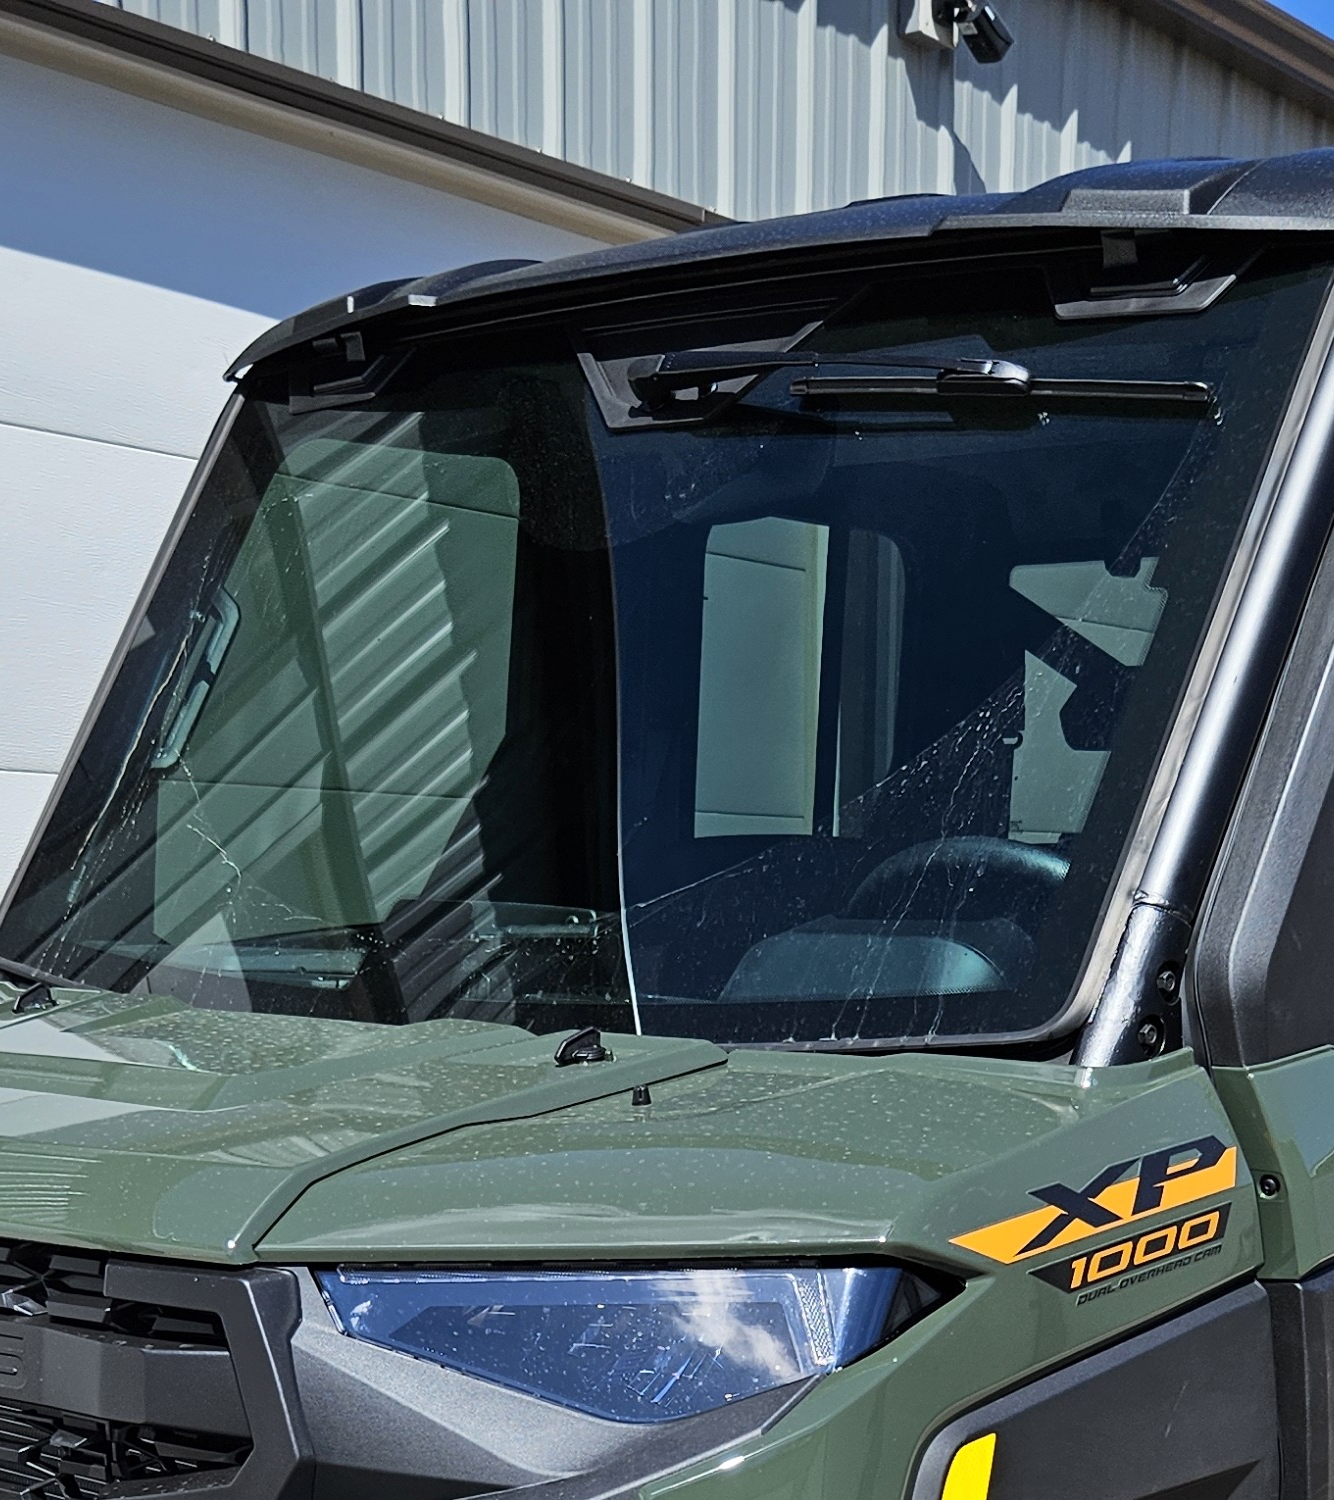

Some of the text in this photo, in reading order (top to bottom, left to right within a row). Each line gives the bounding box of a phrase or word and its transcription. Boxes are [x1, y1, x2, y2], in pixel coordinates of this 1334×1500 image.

[1014, 1134, 1227, 1257] XP
[1070, 1211, 1220, 1289] 1000
[1076, 1244, 1223, 1306] DUAL OVERHEAD CAM
